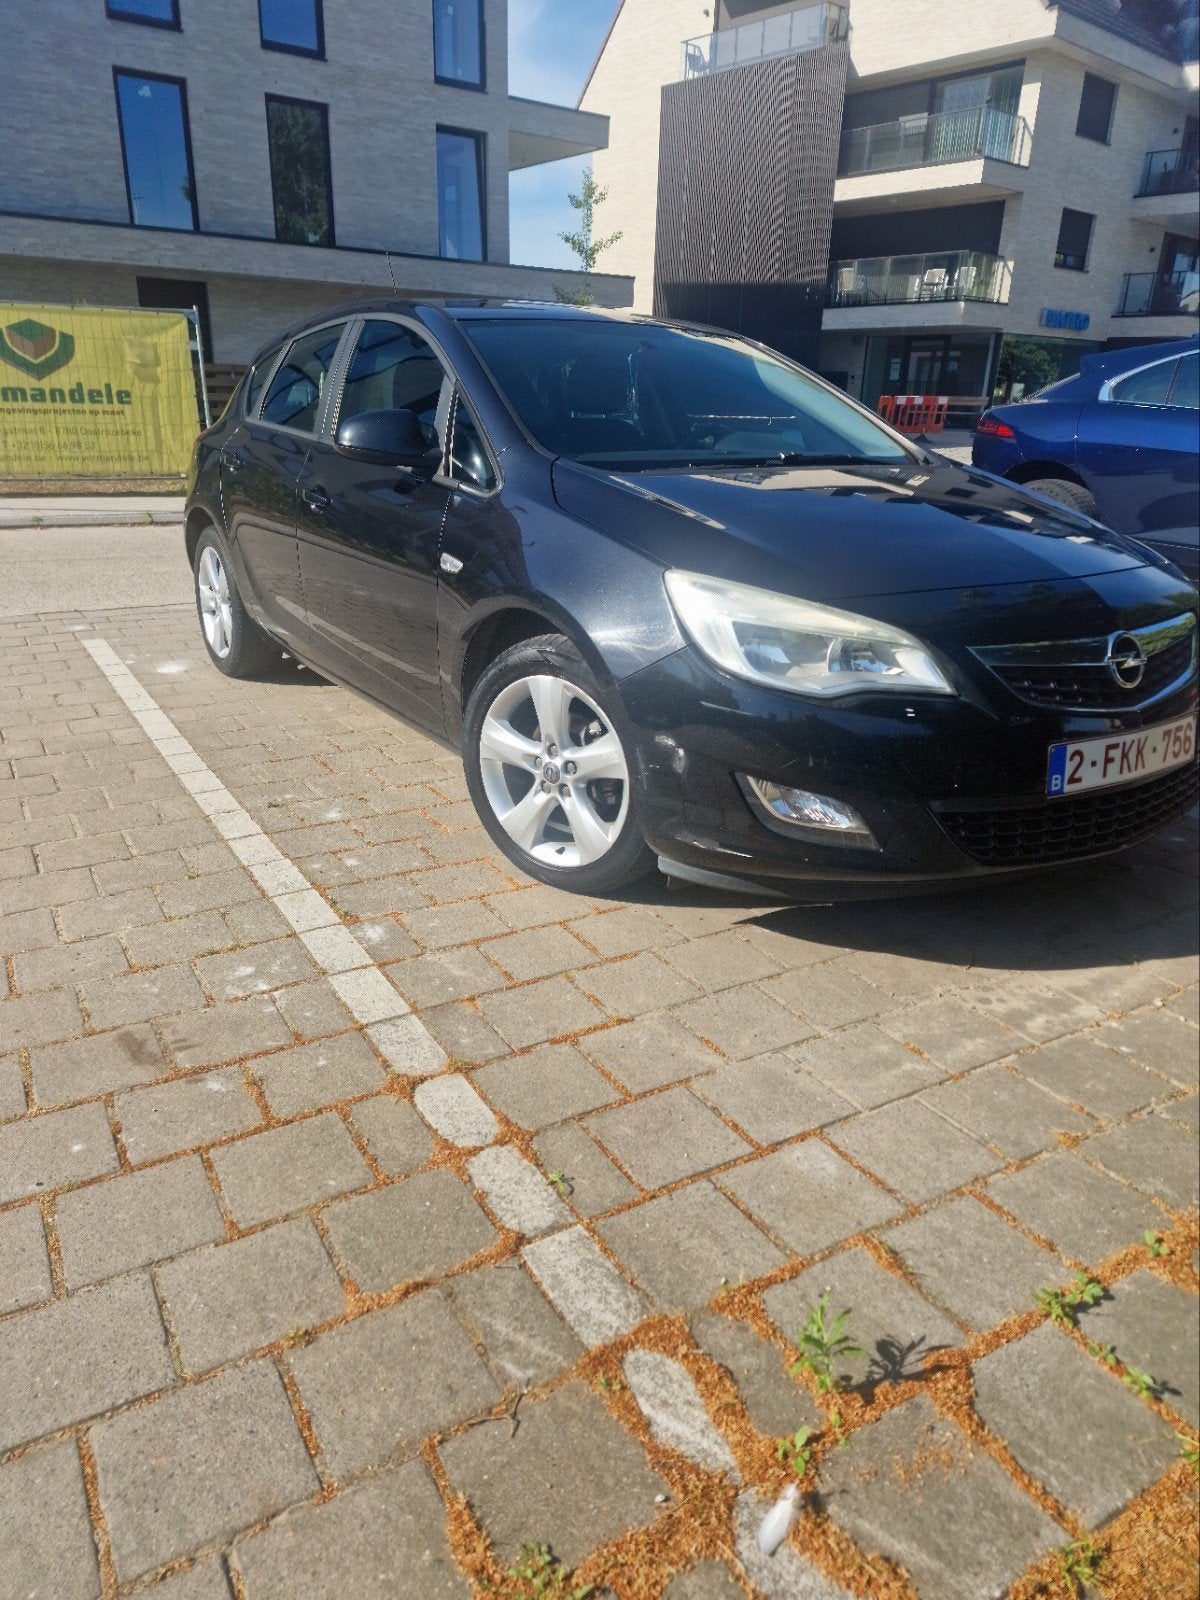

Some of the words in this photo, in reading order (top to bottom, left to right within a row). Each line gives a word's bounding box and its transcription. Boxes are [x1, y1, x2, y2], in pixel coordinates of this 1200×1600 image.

[1, 382, 132, 405] mandele
[102, 409, 125, 417] maat
[1052, 774, 1062, 791] B
